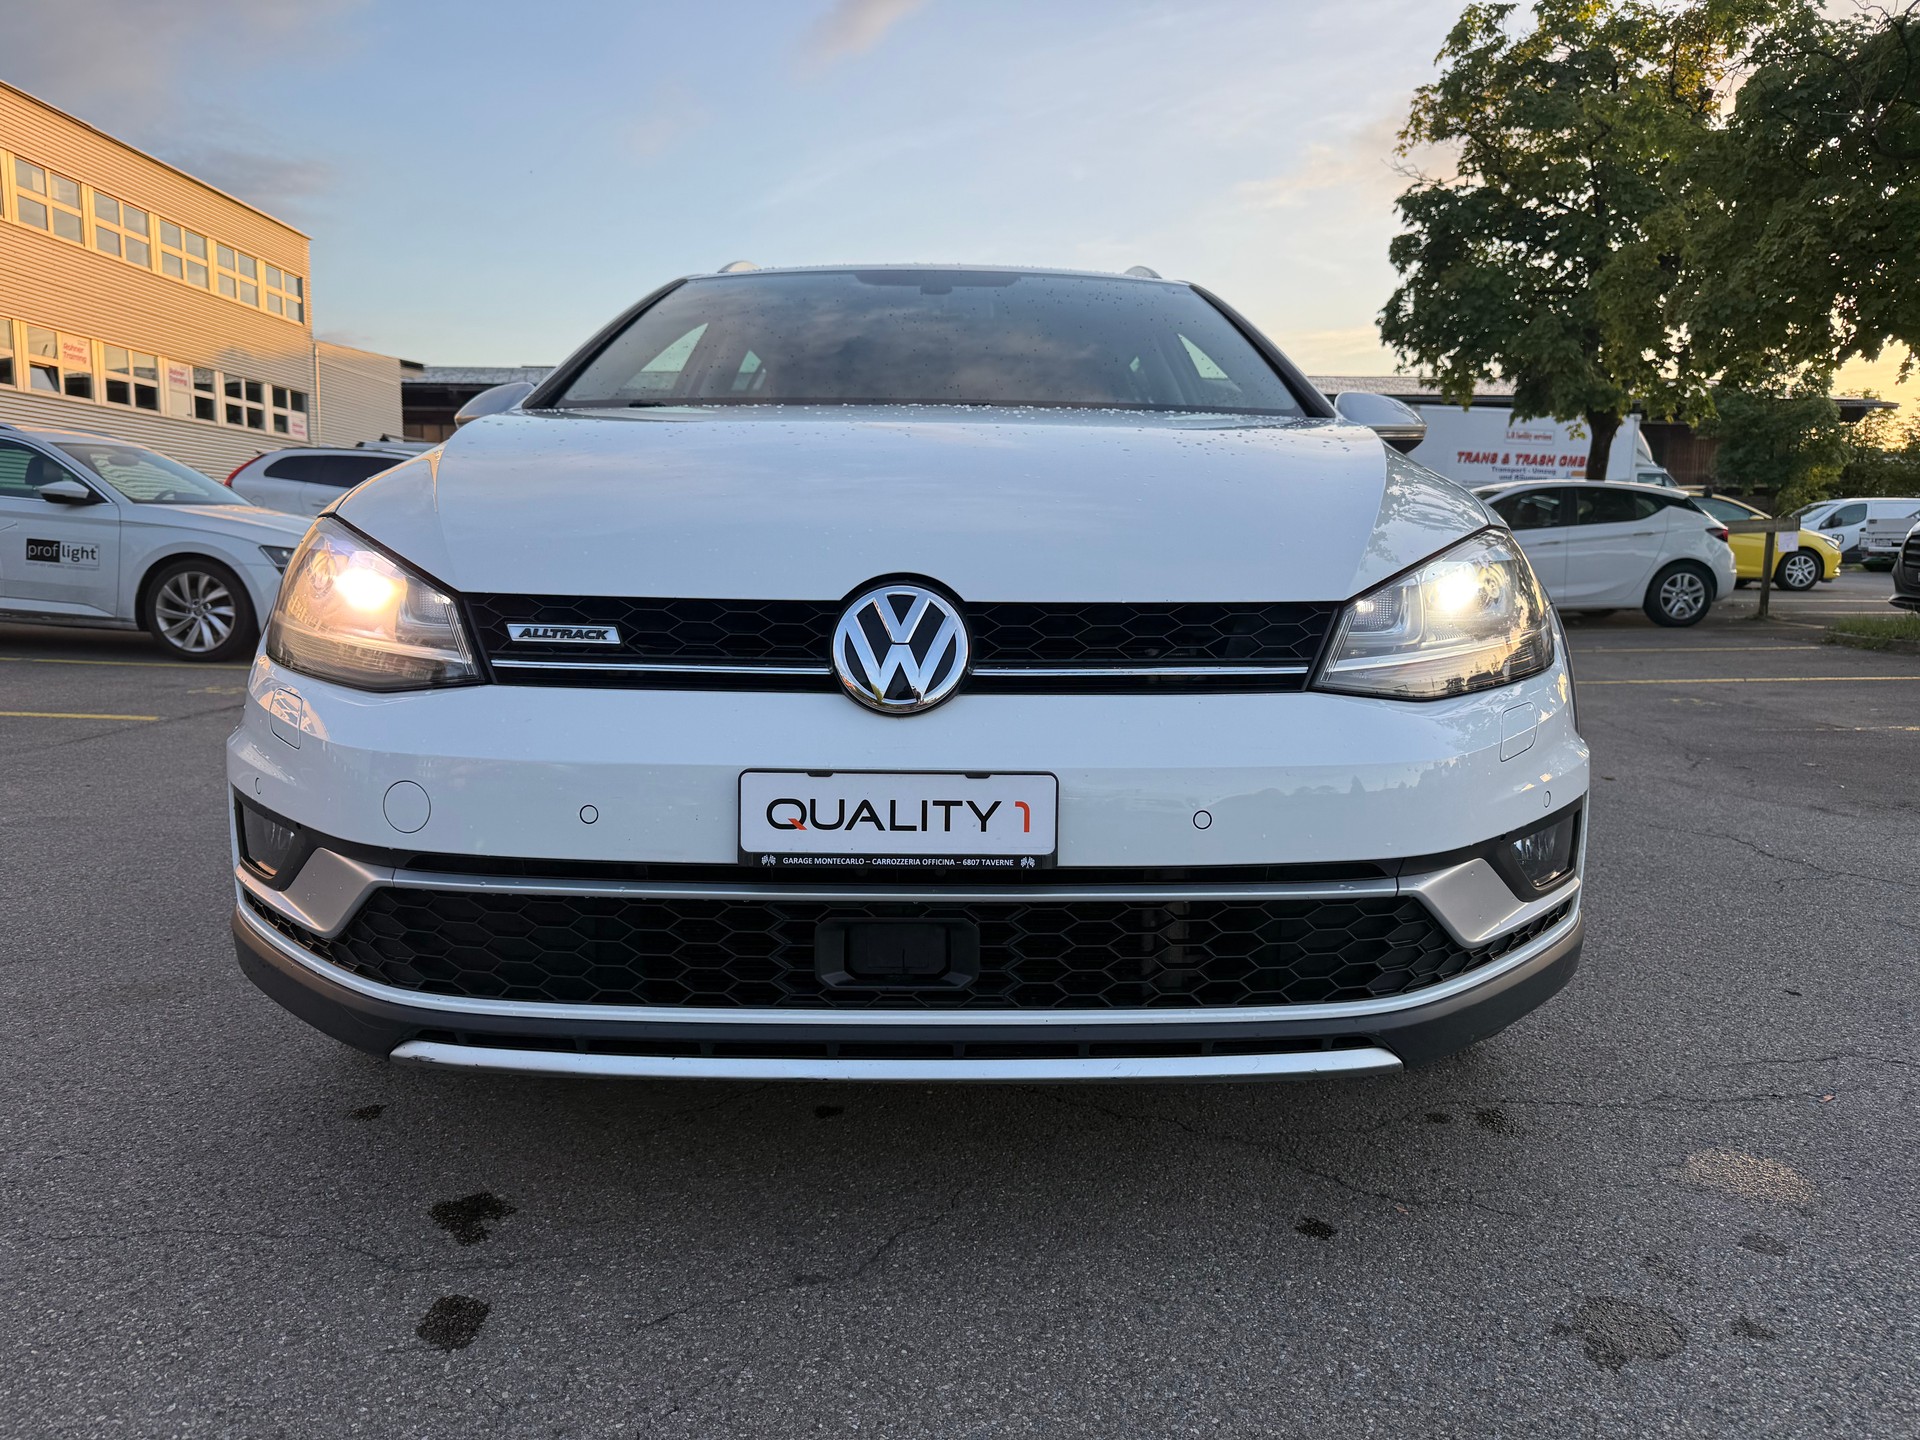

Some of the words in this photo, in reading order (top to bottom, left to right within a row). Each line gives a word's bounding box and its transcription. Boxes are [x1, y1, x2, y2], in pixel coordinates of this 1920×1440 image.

[1456, 451, 1498, 465] TRANS
[1501, 453, 1510, 465] &
[1515, 454, 1556, 467] TRASH
[1559, 456, 1586, 467] GMB
[1491, 466, 1526, 474] Transport
[518, 627, 609, 641] ALLTRACK
[766, 798, 1003, 833] QUALITY
[1014, 800, 1031, 833] 1
[782, 857, 813, 866] GARAGE
[814, 857, 865, 866] MONTECARLO
[871, 858, 921, 866] CARROZZERIA
[922, 858, 956, 867] OFFICINA
[962, 858, 980, 867] 6807
[981, 858, 1014, 867] TAVERNE
